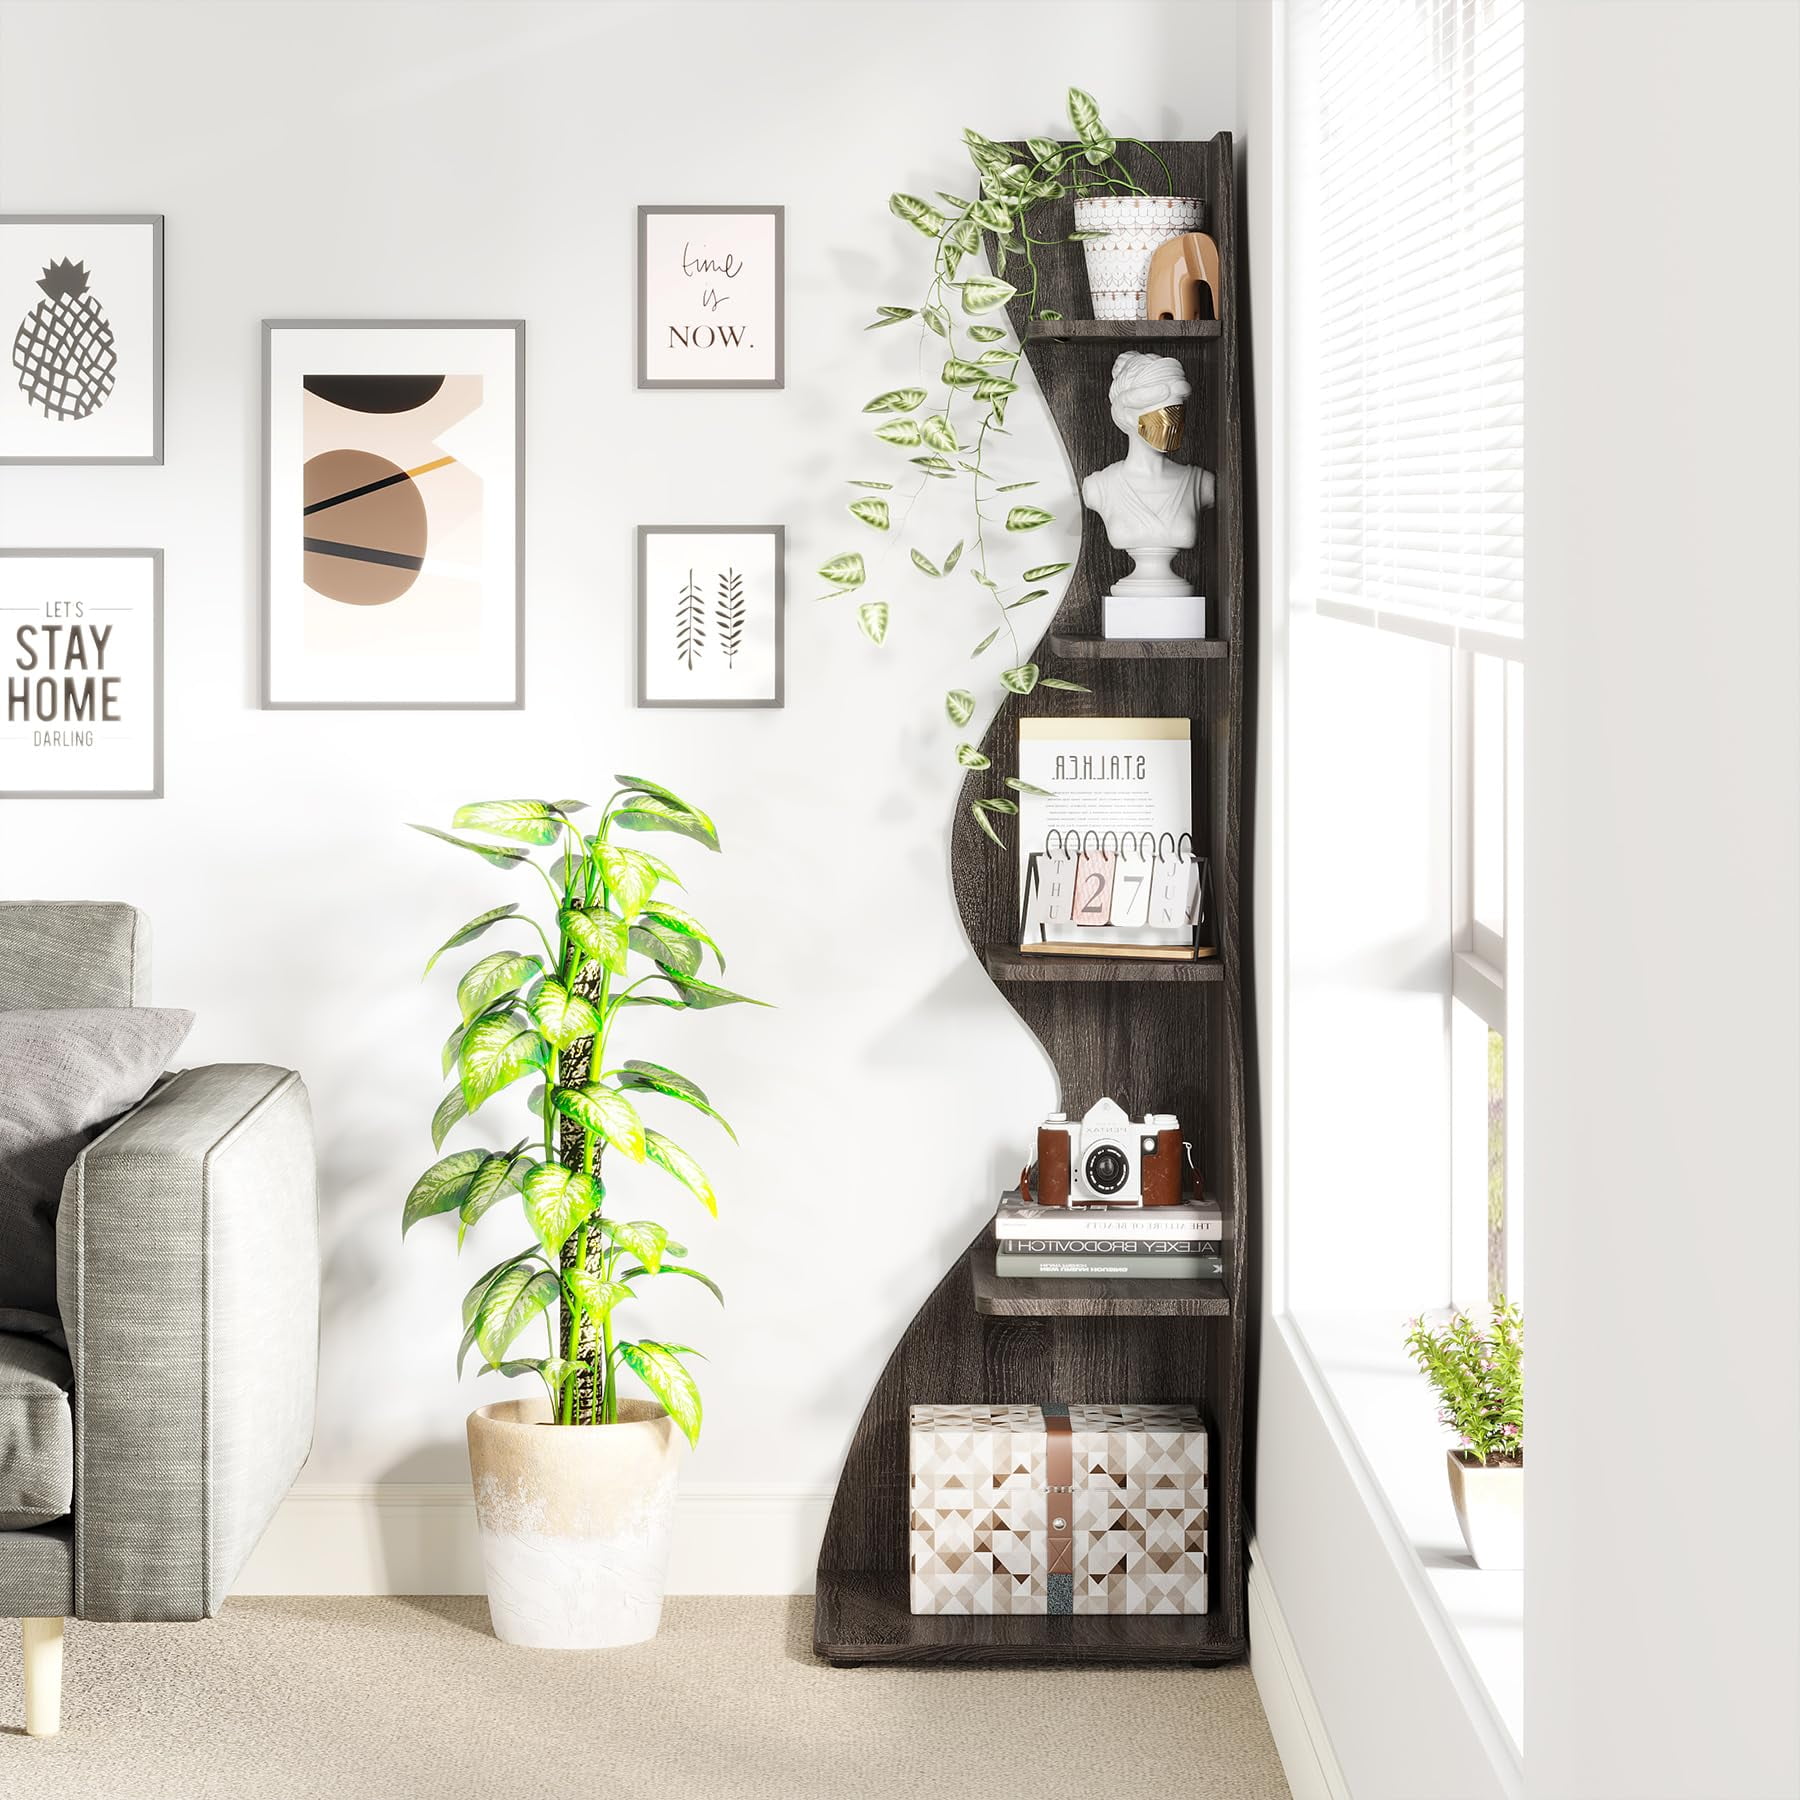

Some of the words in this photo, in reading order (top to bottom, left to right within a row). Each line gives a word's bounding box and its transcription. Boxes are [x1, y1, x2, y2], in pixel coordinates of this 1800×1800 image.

[682, 241, 743, 278] time
[702, 283, 730, 312] is
[668, 325, 754, 349] NOW.
[16, 624, 113, 671] STAY
[8, 676, 122, 722] HOME
[33, 730, 94, 747] DARLING
